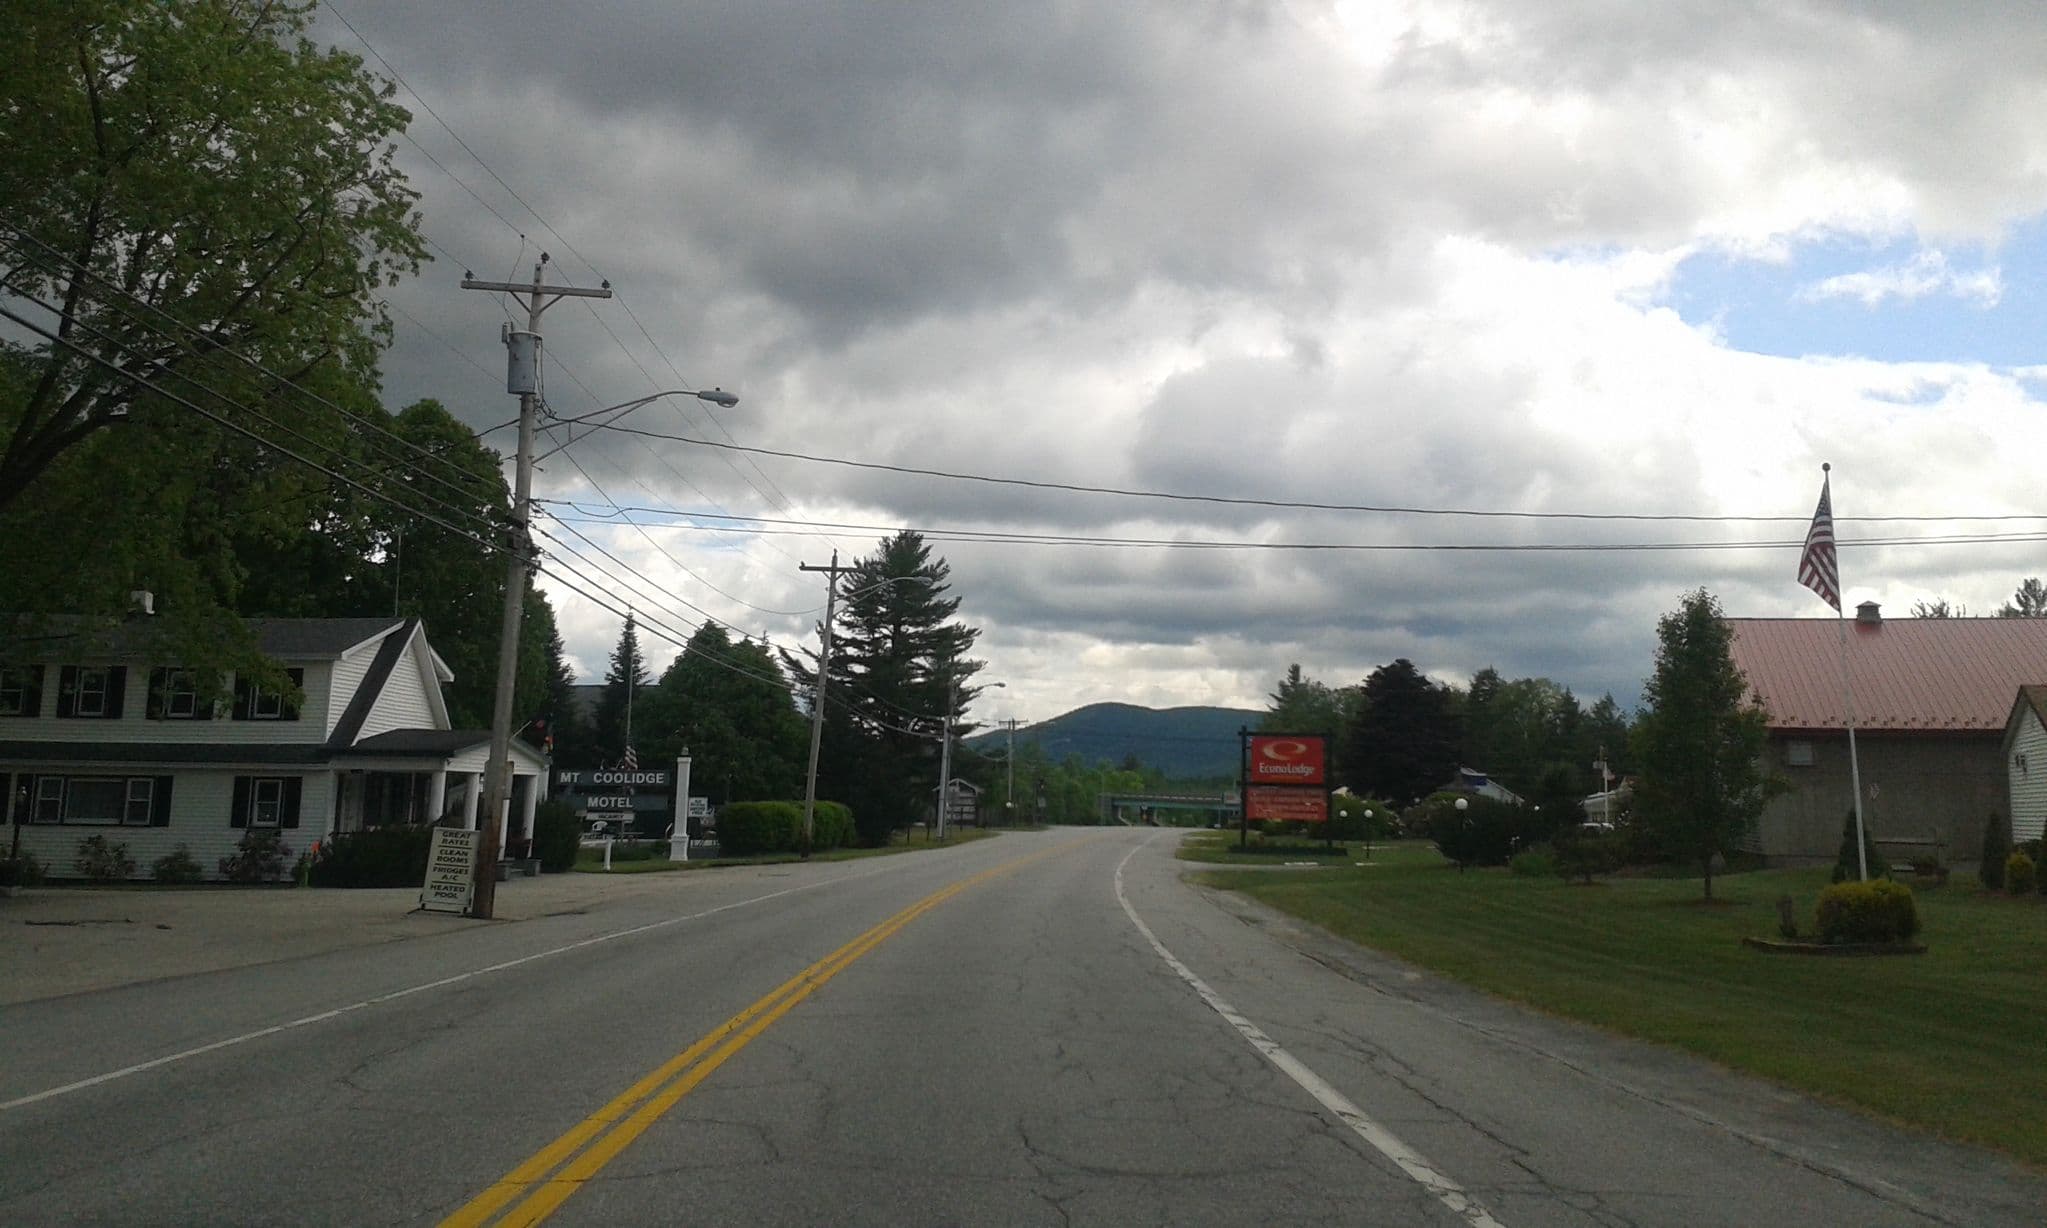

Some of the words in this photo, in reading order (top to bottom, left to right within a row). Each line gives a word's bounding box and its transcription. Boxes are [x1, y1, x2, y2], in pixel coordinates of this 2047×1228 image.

[560, 772, 580, 783] MT
[593, 772, 665, 784] COOLIDGE
[587, 796, 634, 808] MOTEL
[442, 831, 470, 839] GREAT
[439, 849, 469, 857] CLEAN
[437, 855, 468, 864] ROOMS
[430, 884, 465, 892] HEATED
